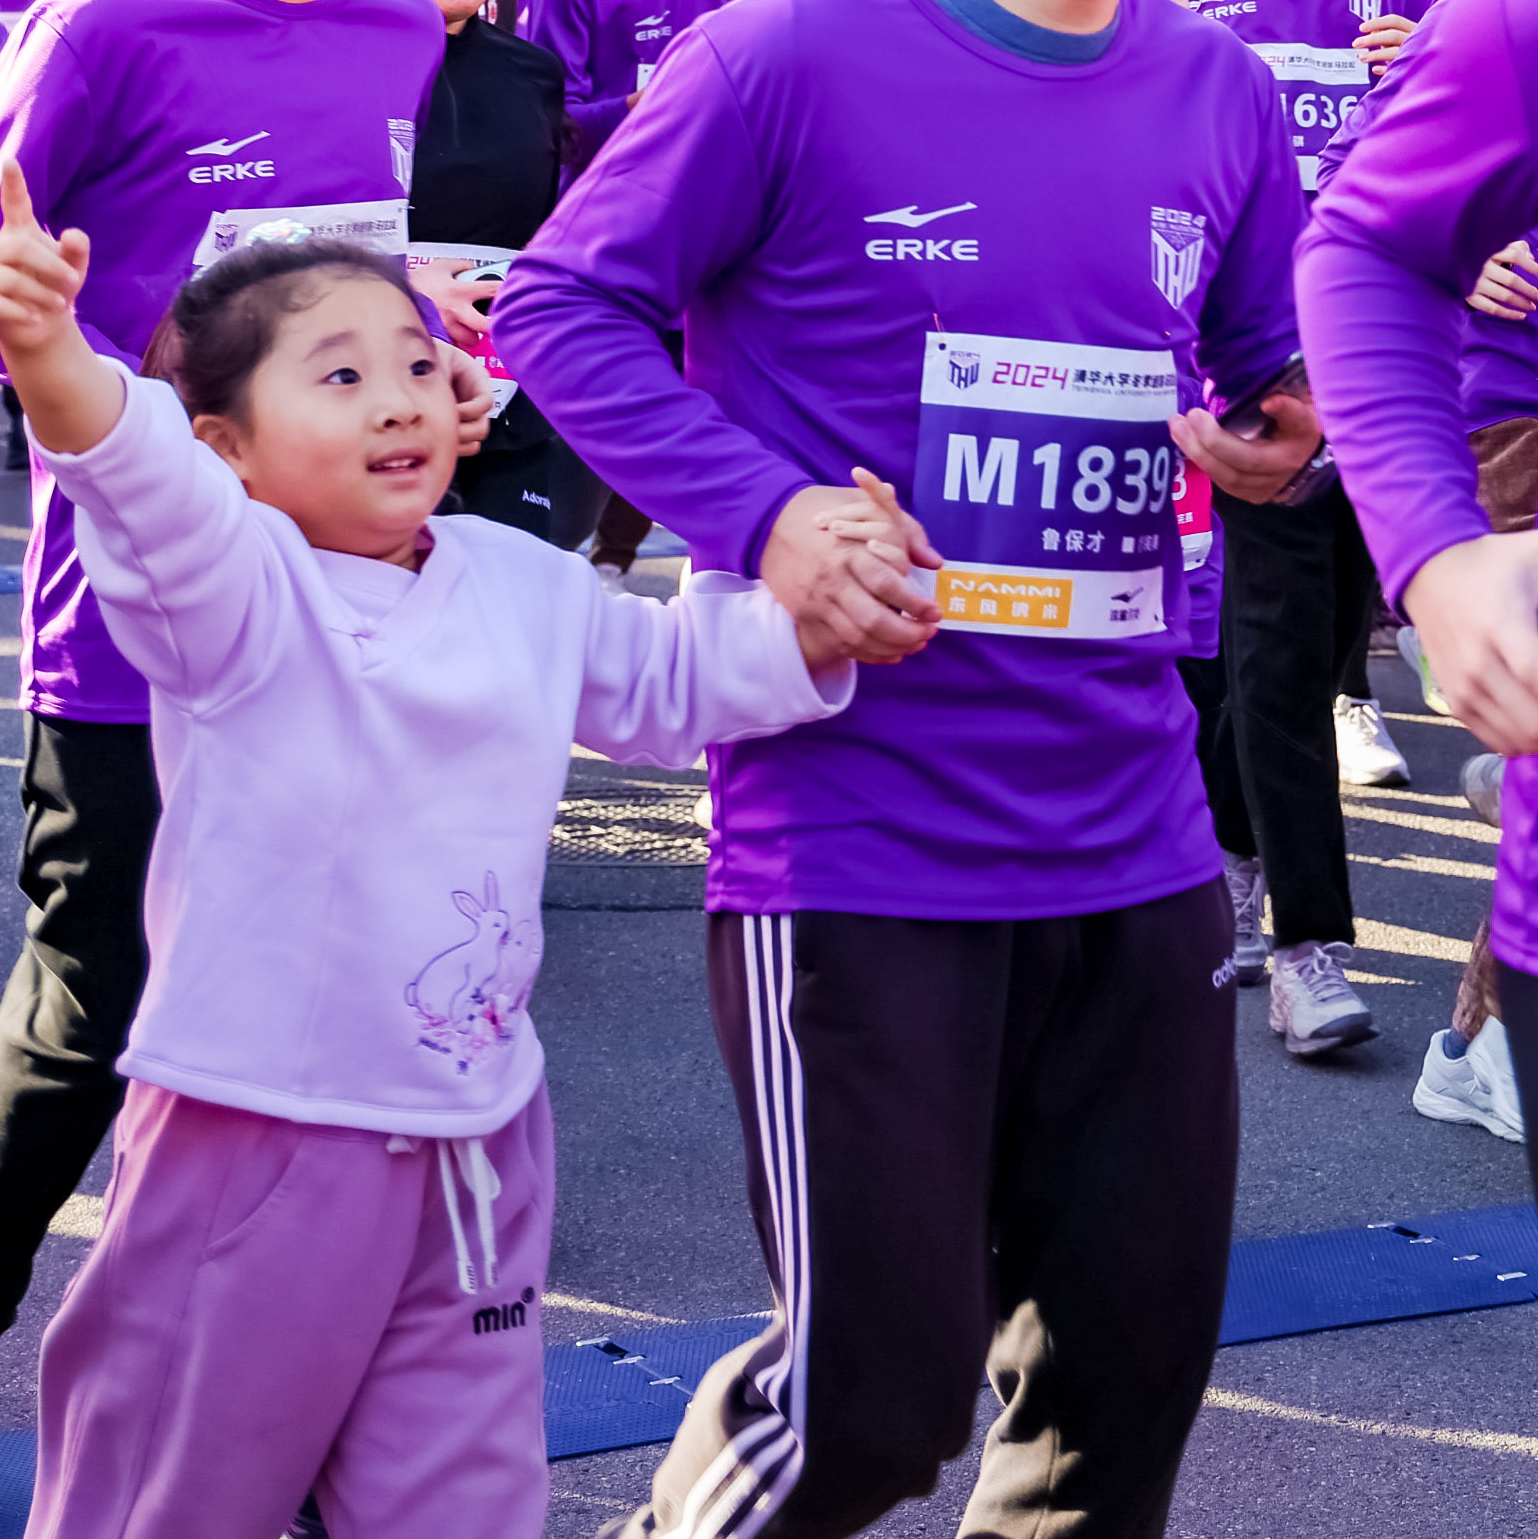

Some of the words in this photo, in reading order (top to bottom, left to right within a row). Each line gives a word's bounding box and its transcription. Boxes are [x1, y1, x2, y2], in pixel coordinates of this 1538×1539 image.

[1203, 0, 1258, 20] ERKE
[635, 26, 672, 42] ERE
[188, 160, 276, 184] ERKE
[865, 238, 980, 262] ERKE
[406, 256, 431, 270] 24
[991, 361, 1069, 391] 2024
[942, 432, 1170, 516] M1839
[950, 578, 1061, 598] NAMMI
